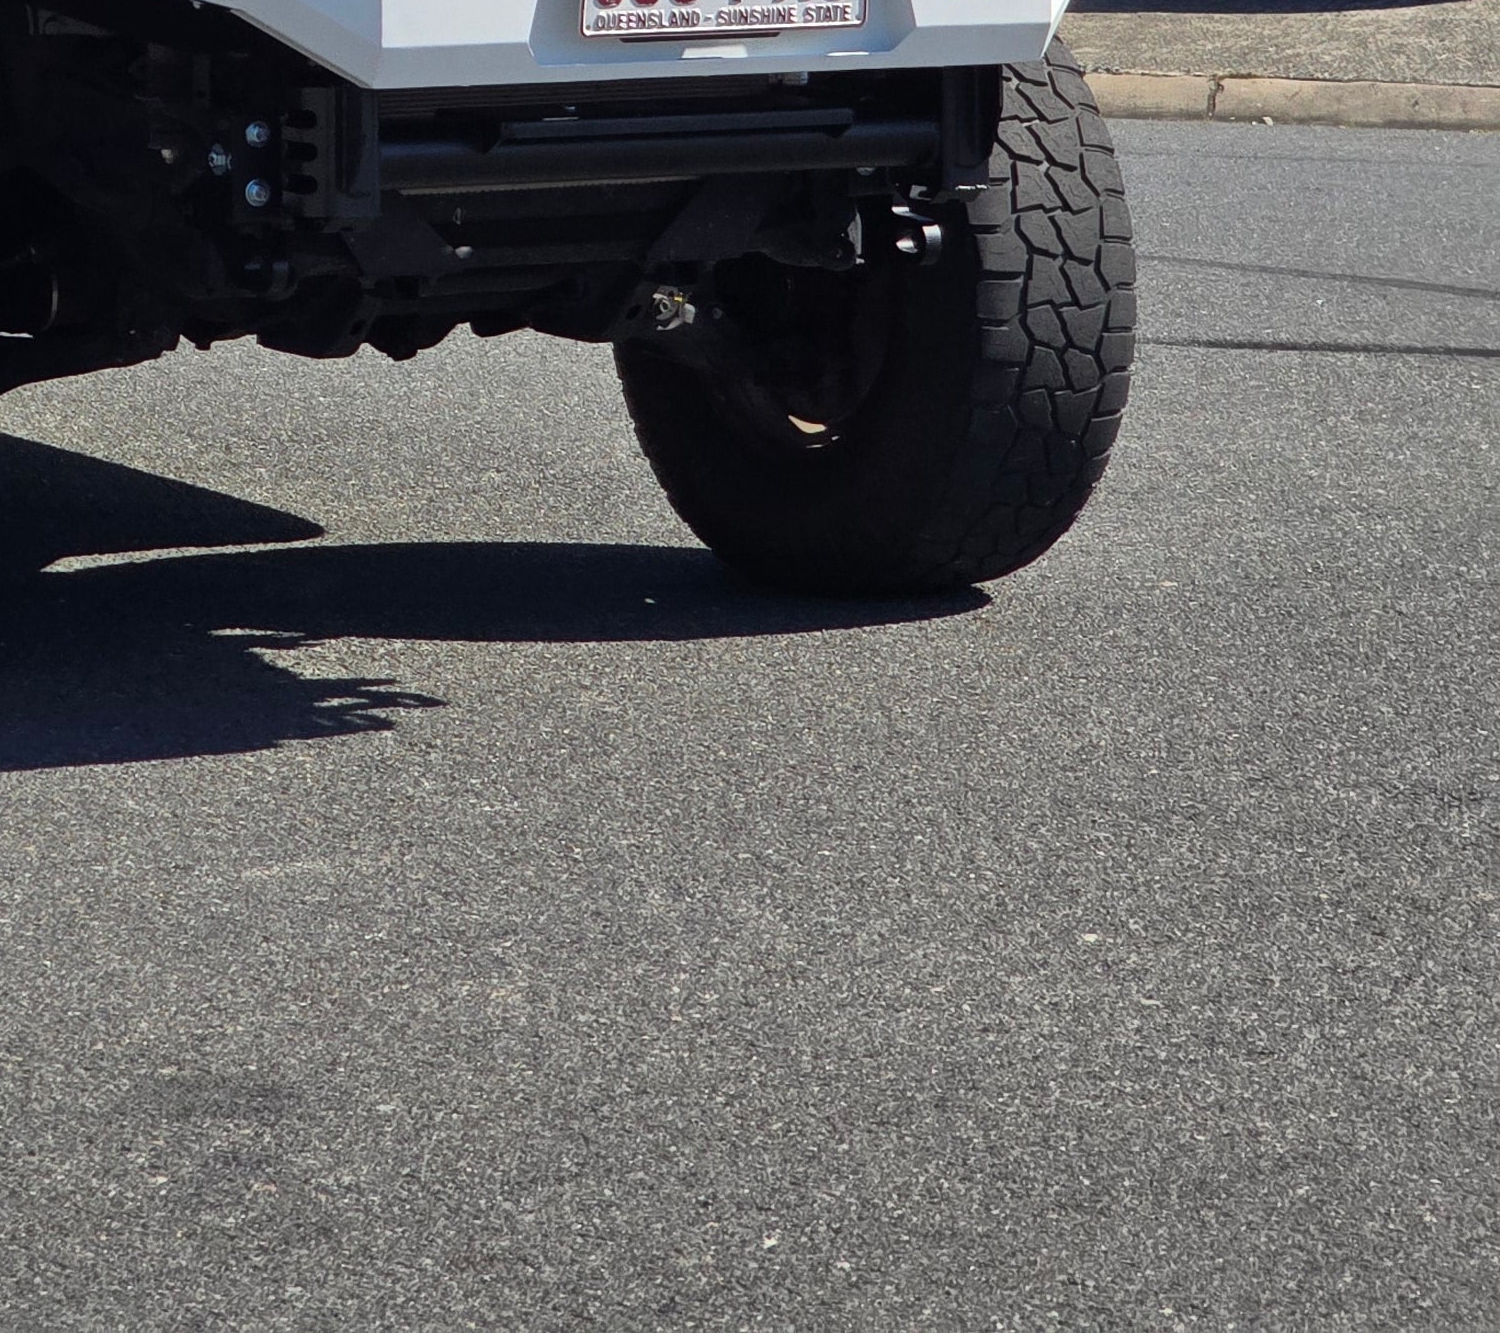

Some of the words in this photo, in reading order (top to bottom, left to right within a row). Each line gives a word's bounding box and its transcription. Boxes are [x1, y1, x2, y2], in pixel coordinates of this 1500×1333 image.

[595, 9, 700, 31] QUEENSLAND
[715, 6, 798, 28] SUNSHINE
[803, 3, 852, 22] STATE
